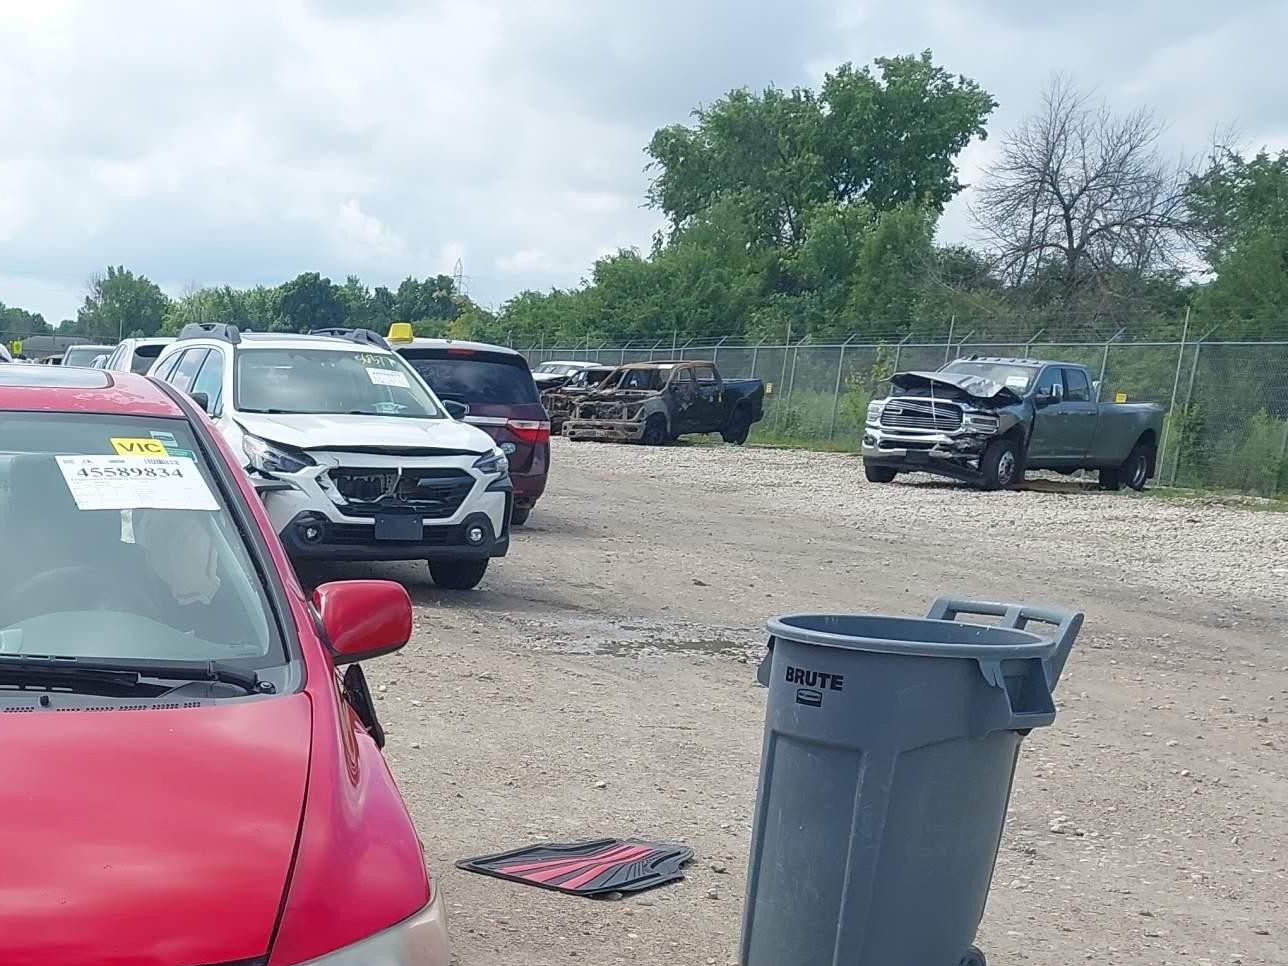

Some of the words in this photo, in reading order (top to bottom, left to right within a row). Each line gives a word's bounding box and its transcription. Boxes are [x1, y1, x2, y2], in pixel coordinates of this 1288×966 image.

[117, 442, 162, 453] VIC
[76, 467, 184, 478] 45589834
[785, 666, 844, 691] BRUTE
